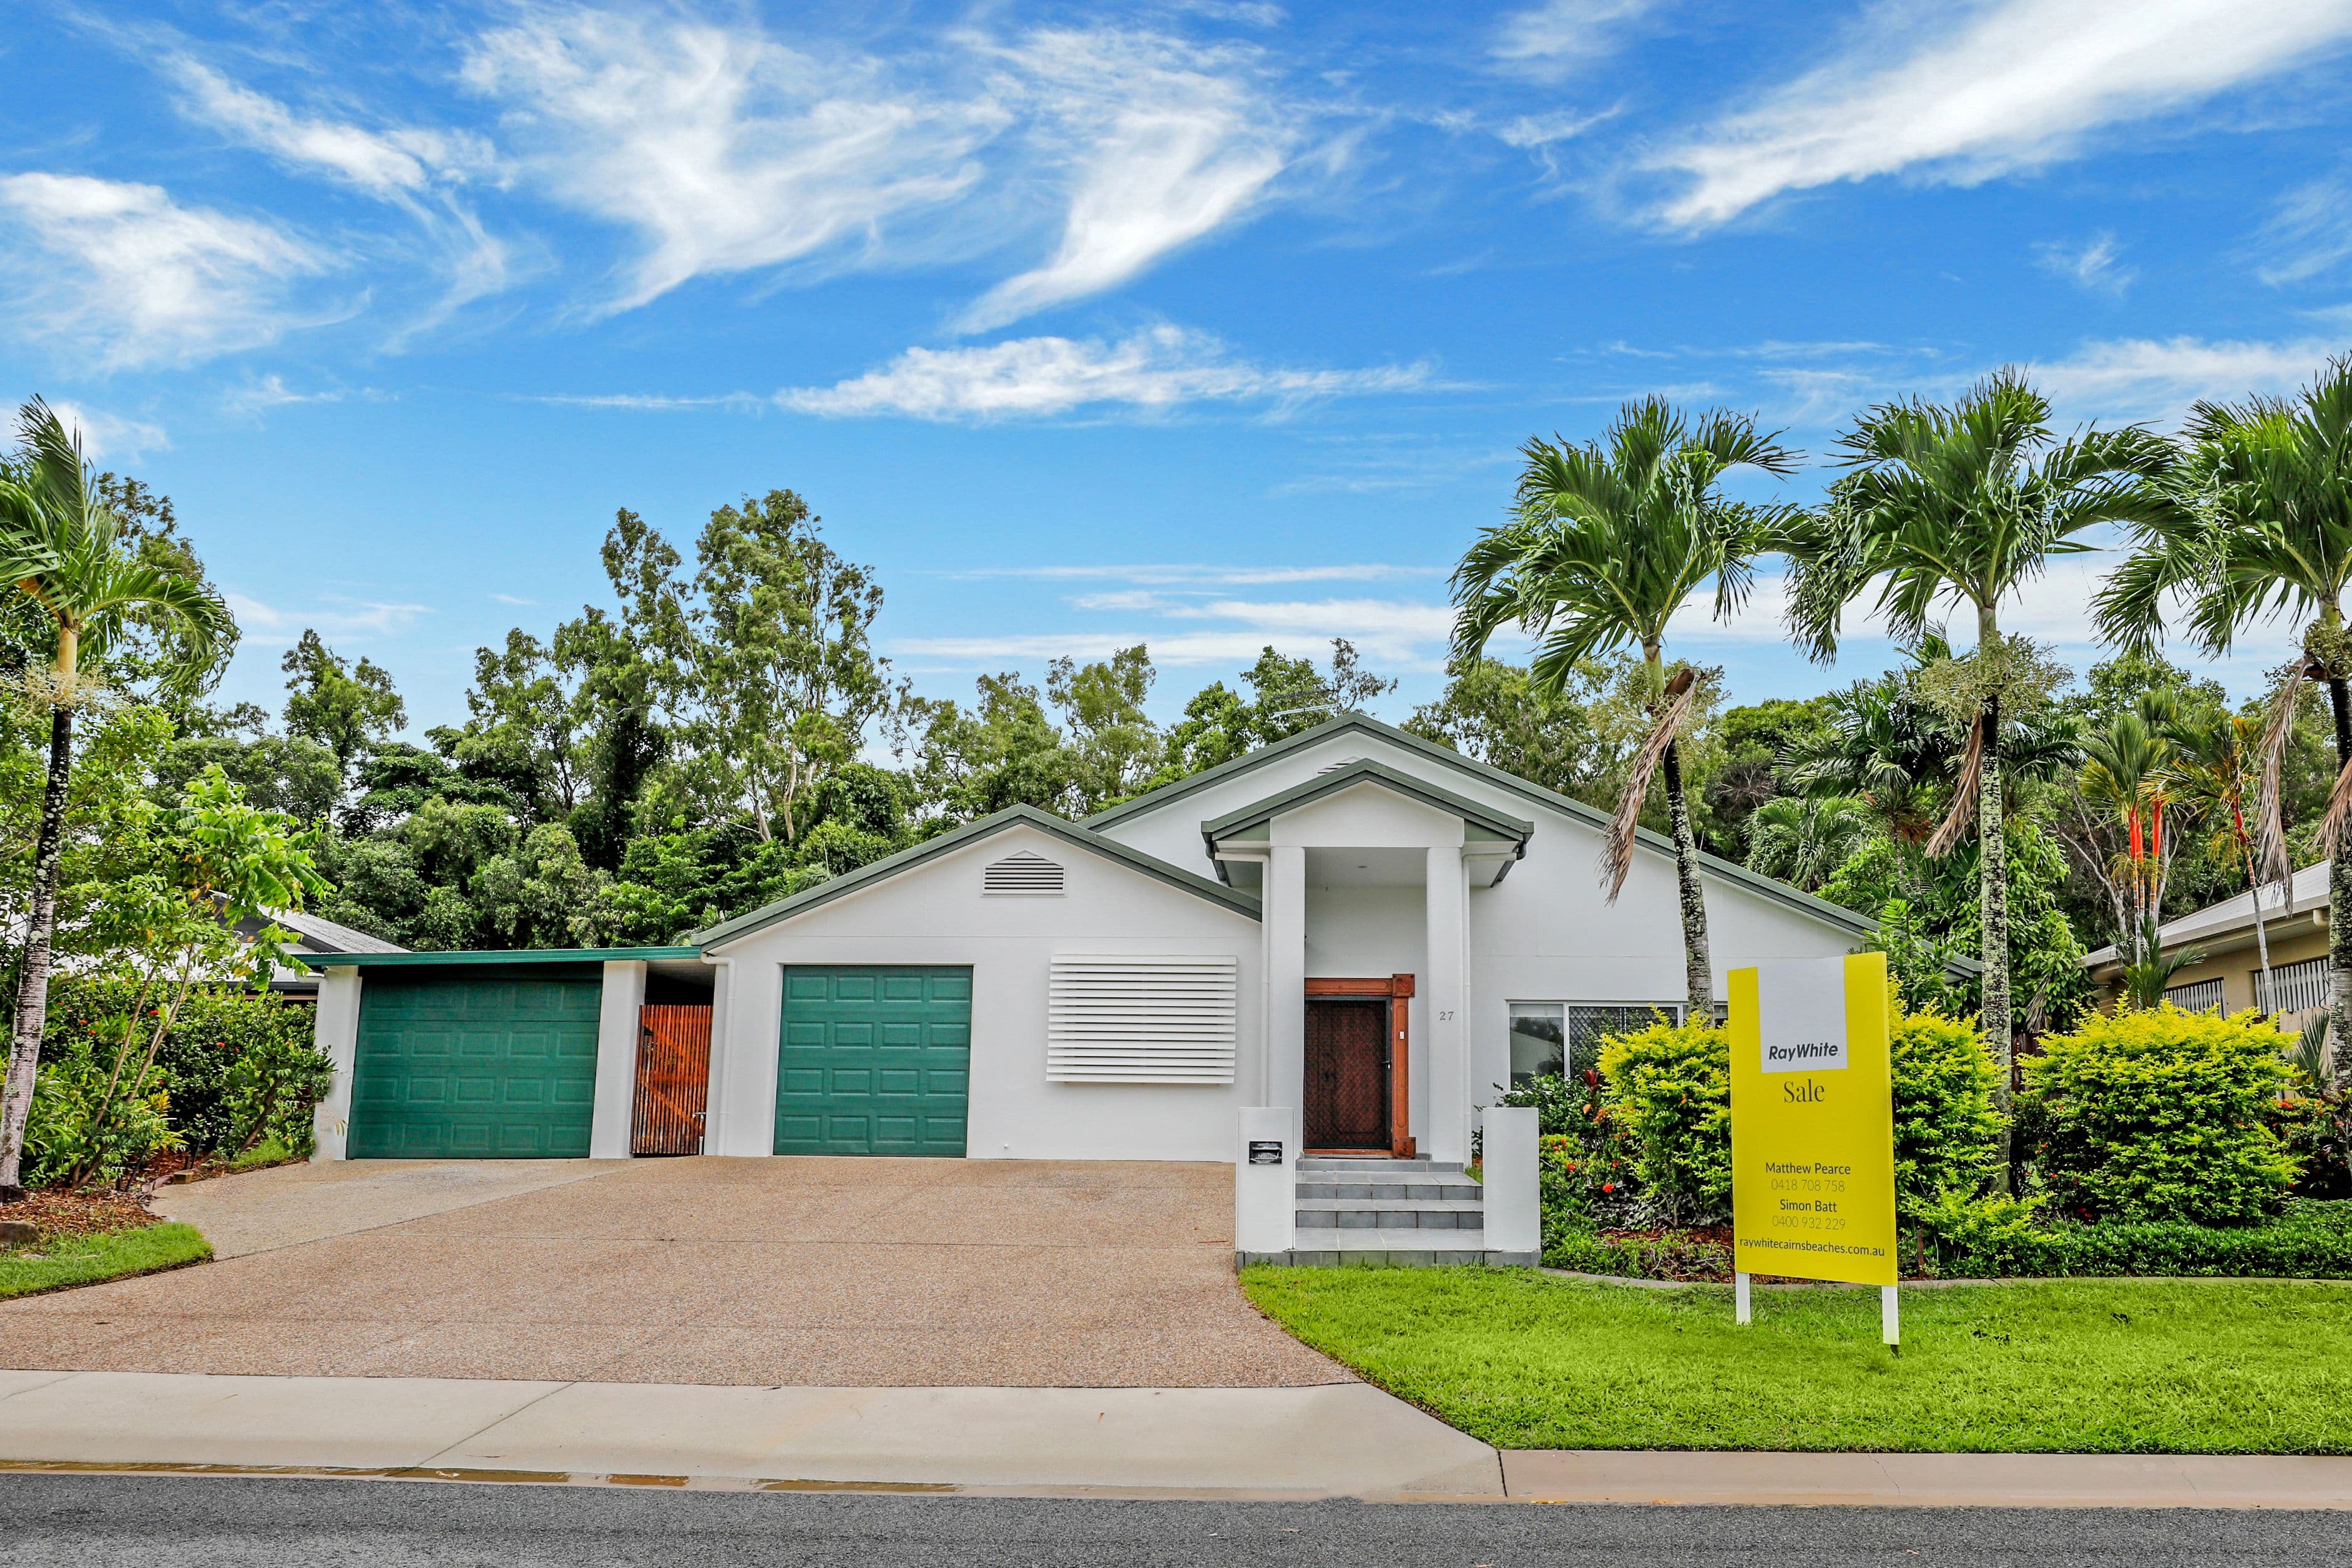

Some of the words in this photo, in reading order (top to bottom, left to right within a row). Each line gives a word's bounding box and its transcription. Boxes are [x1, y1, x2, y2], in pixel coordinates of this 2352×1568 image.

[1439, 1011, 1454, 1021] 27
[1768, 1042, 1839, 1061] RayWhite
[1783, 1078, 1825, 1103] Sale
[1765, 1162, 1811, 1174] Matthew
[1815, 1162, 1851, 1175] Pearce
[1771, 1178, 1798, 1191] 0418
[1801, 1179, 1821, 1192] 708
[1825, 1180, 1845, 1192] 758
[1780, 1198, 1811, 1211] Simon
[1815, 1200, 1838, 1212] Batt
[1772, 1215, 1799, 1228] 0400
[1801, 1217, 1821, 1229] 932
[1825, 1218, 1846, 1231] 229
[1739, 1237, 1885, 1257] raywhitecairnsbeaches.com.au
